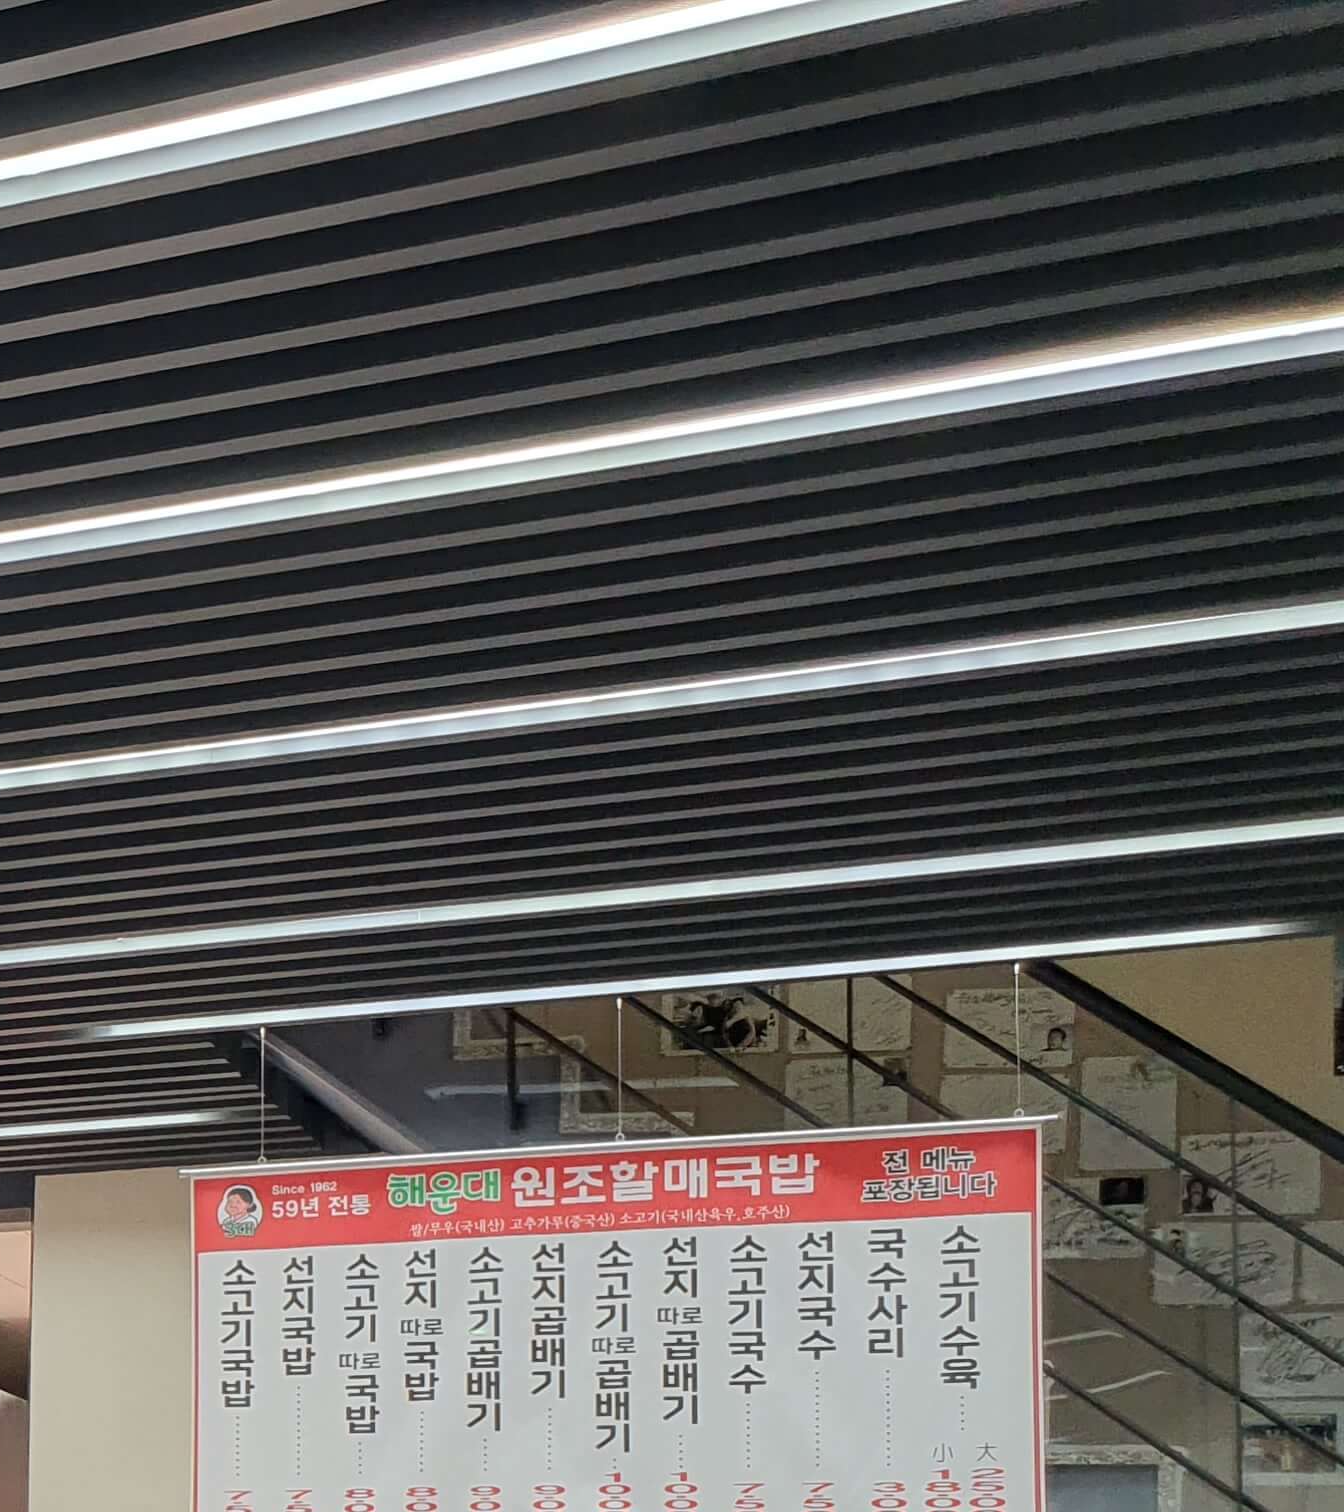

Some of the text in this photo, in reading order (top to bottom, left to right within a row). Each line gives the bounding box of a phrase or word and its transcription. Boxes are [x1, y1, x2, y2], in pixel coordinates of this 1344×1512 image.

[271, 1181, 337, 1196] Since 1962
[386, 1152, 820, 1215] 해운대 원조할매국밥
[861, 1172, 996, 1203] 포장됩니다
[883, 1146, 976, 1175] 전 메뉴
[271, 1193, 372, 1219] 59년 전통
[343, 1253, 380, 1343] 소고기
[403, 1248, 438, 1309] 선지
[595, 1240, 633, 1333] 소고기
[663, 1236, 698, 1298] 선지
[797, 1231, 837, 1361] 선지국수
[867, 1228, 908, 1359] 국수사리
[220, 1259, 257, 1408] 소고기국밥
[281, 1255, 315, 1376] 선지국밥
[400, 1318, 445, 1336] 따로
[530, 1242, 567, 1399] 선지곱배기
[657, 1306, 703, 1326] 따로
[727, 1234, 768, 1394] 소고기국수
[939, 1225, 981, 1389] 소고기수육
[339, 1352, 381, 1370] 따로
[467, 1246, 504, 1432] 소고기곱배기
[591, 1336, 637, 1356] 따로
[404, 1341, 439, 1402] 국밥
[662, 1331, 700, 1425] 곱배기
[344, 1374, 380, 1434] 국밥
[595, 1359, 632, 1453] 곱배기
